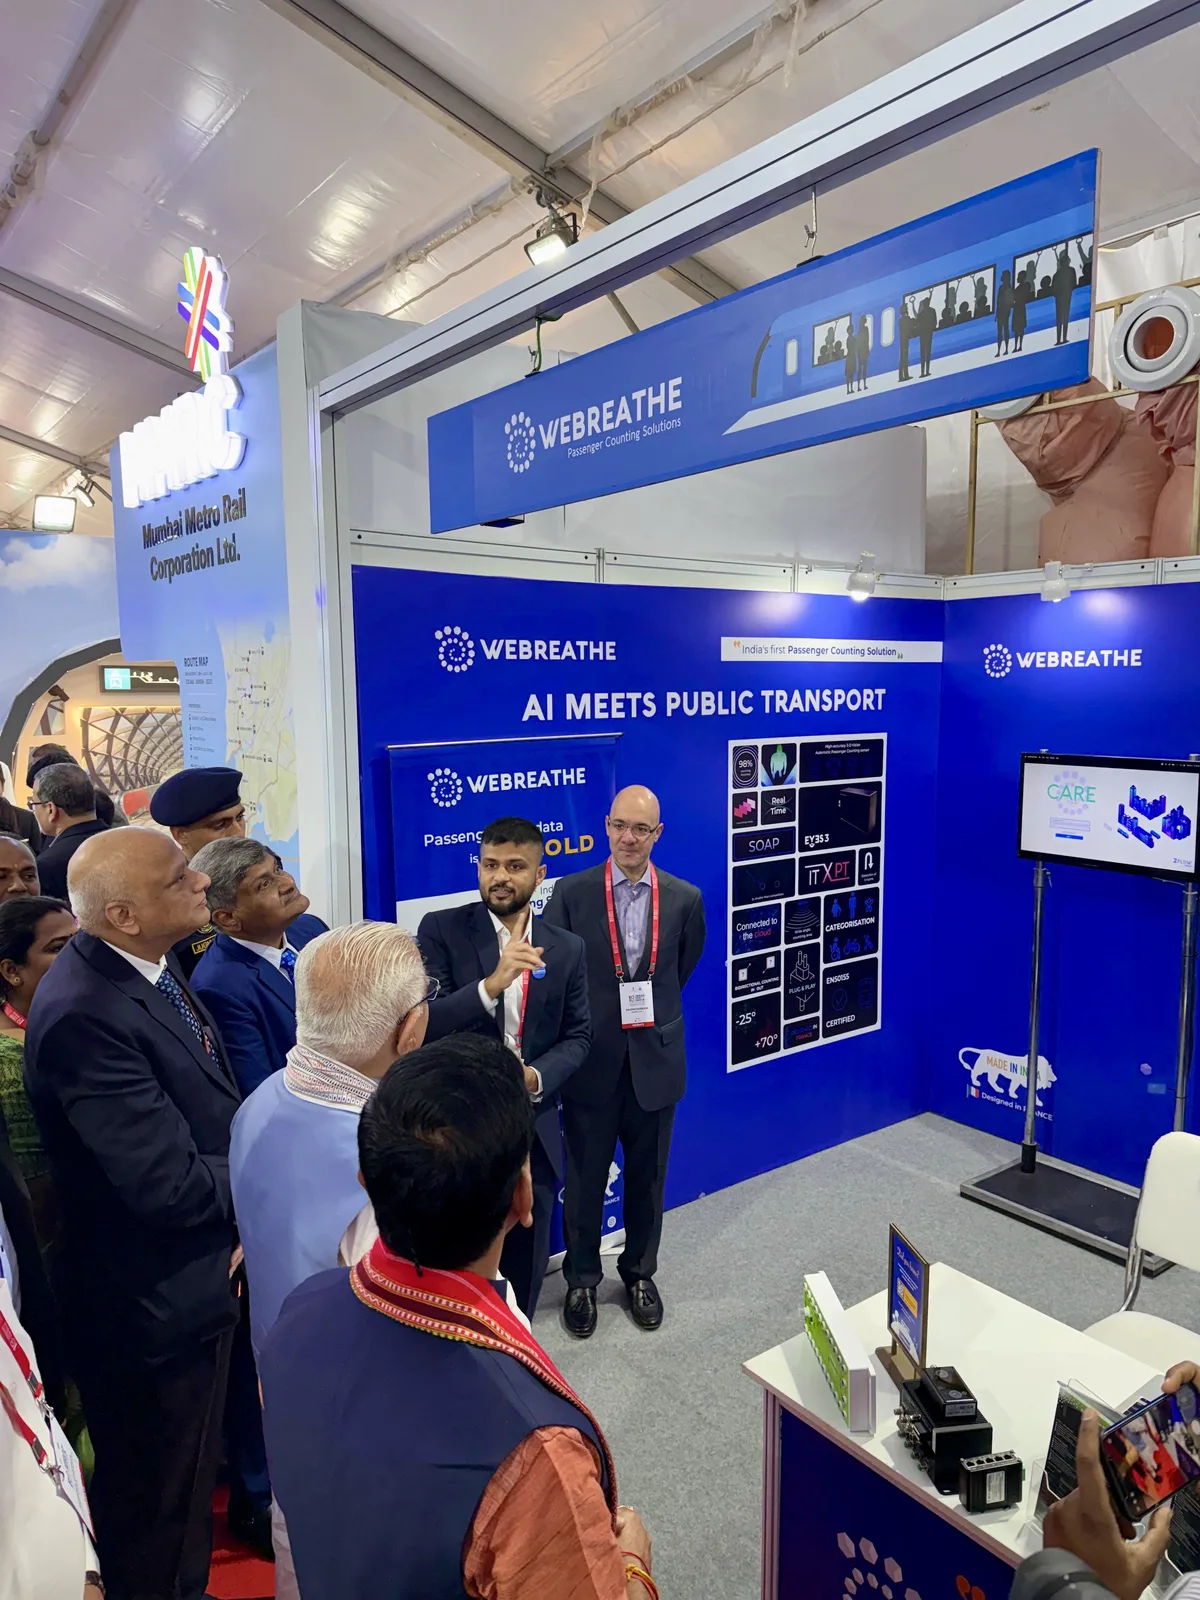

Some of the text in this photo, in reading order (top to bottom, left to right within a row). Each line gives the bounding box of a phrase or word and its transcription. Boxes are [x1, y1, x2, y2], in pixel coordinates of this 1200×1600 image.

[539, 376, 682, 450] WEBREATHE
[567, 416, 682, 458] Passenger Counting Solutions
[142, 487, 247, 549] Mumbai Metro Rail
[150, 533, 241, 583] Corporation Ltd.
[480, 639, 616, 661] WEBREATHE
[742, 644, 897, 658] India's first Passenger Counting Solution
[1016, 649, 1143, 669] WEBREATHE
[521, 688, 887, 721] AI MEETS PUBLIC TRANSPORT
[738, 760, 753, 769] 98%
[467, 767, 586, 794] WEBREATHE
[771, 796, 786, 805] Real
[1047, 784, 1096, 803] CARE
[770, 807, 787, 815] Time
[424, 831, 484, 847] Passeng
[545, 834, 594, 856] OLD
[749, 837, 780, 852] SOAP
[736, 917, 778, 932] Connected to
[825, 916, 875, 932] CATEGORISATION
[742, 928, 771, 941] the cloud
[761, 976, 780, 985] COUNTING
[826, 1014, 856, 1028] CERTIFIED
[986, 1056, 1041, 1081] MADE IN INA
[982, 1092, 1013, 1108] Designed
